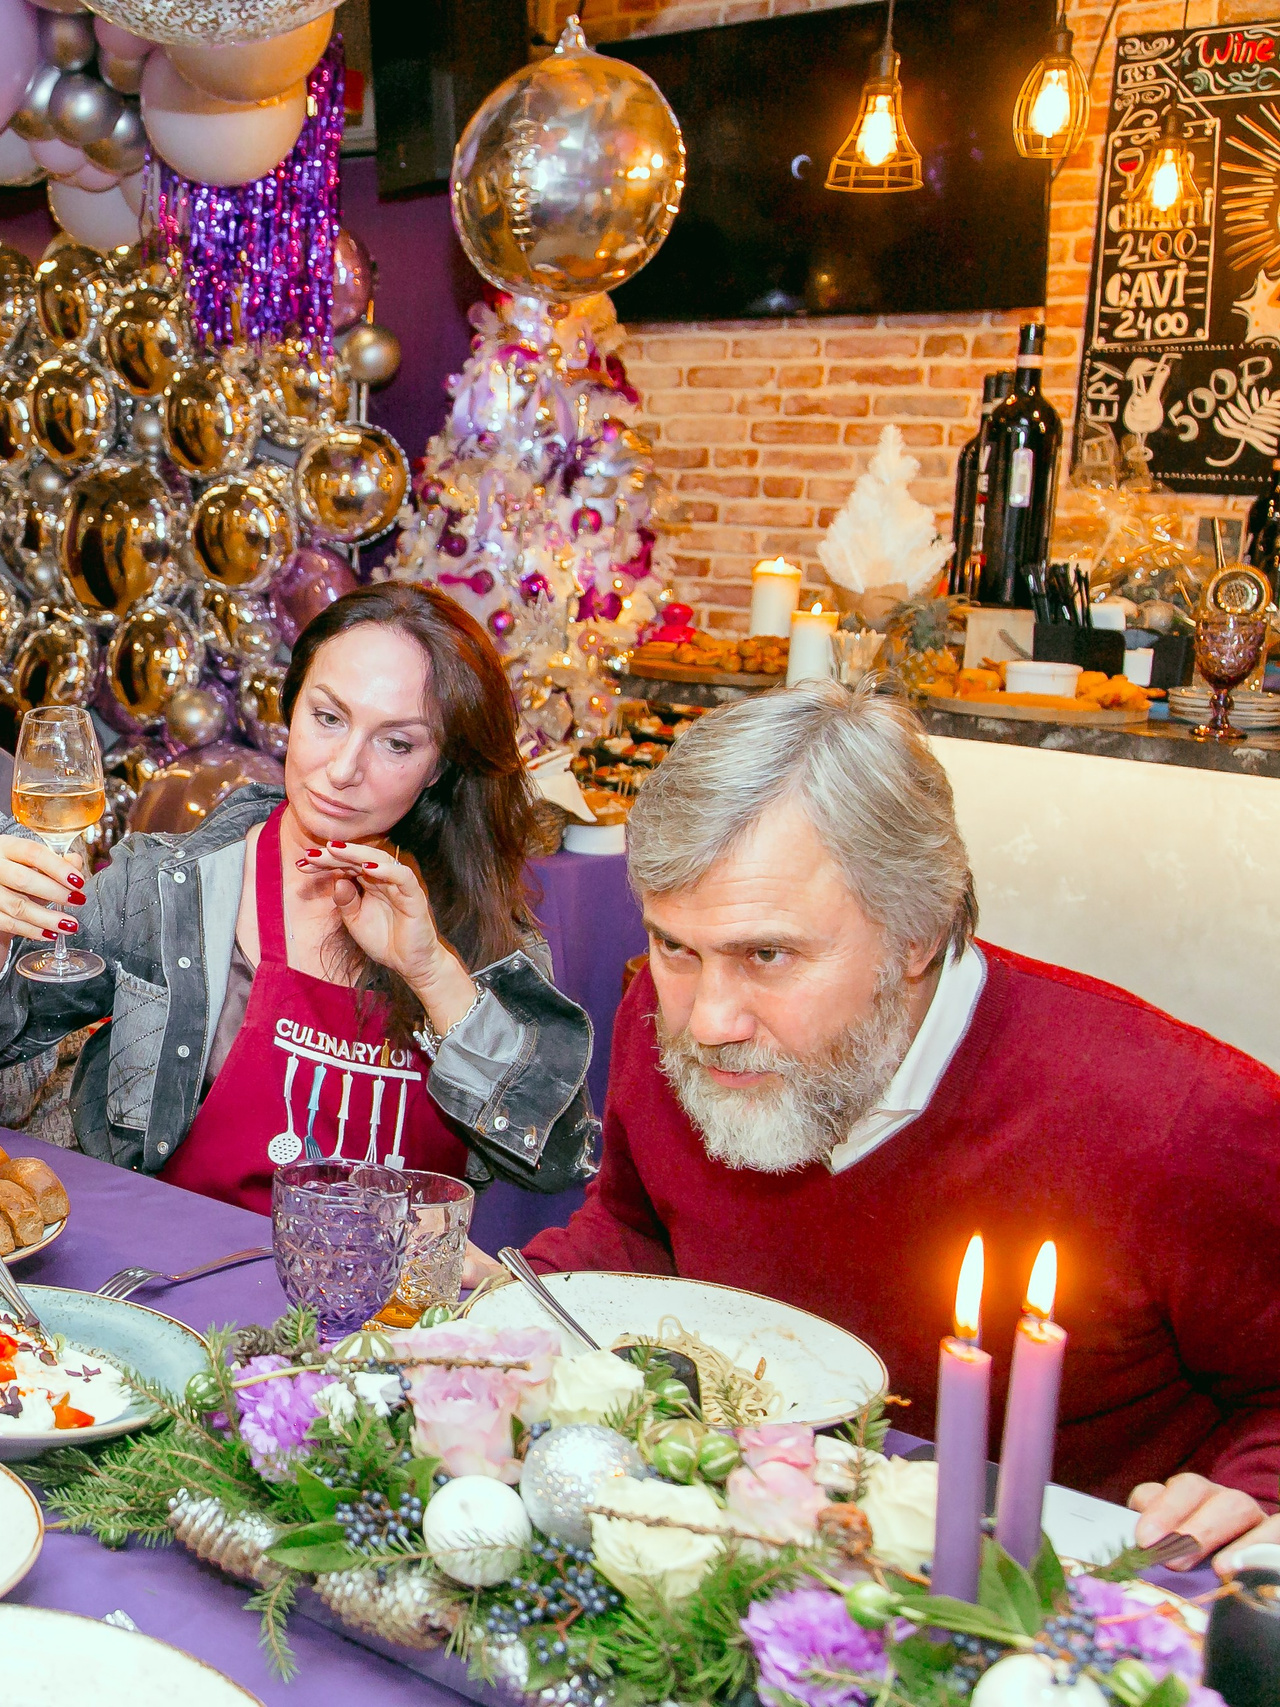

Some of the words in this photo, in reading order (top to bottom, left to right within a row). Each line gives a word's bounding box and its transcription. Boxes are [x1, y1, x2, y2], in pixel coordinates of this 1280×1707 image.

[1195, 32, 1275, 68] Wine
[1117, 229, 1198, 267] 2400
[1113, 310, 1189, 341] 2400
[1082, 361, 1125, 466] EVERY
[275, 1018, 382, 1065] CULINARY
